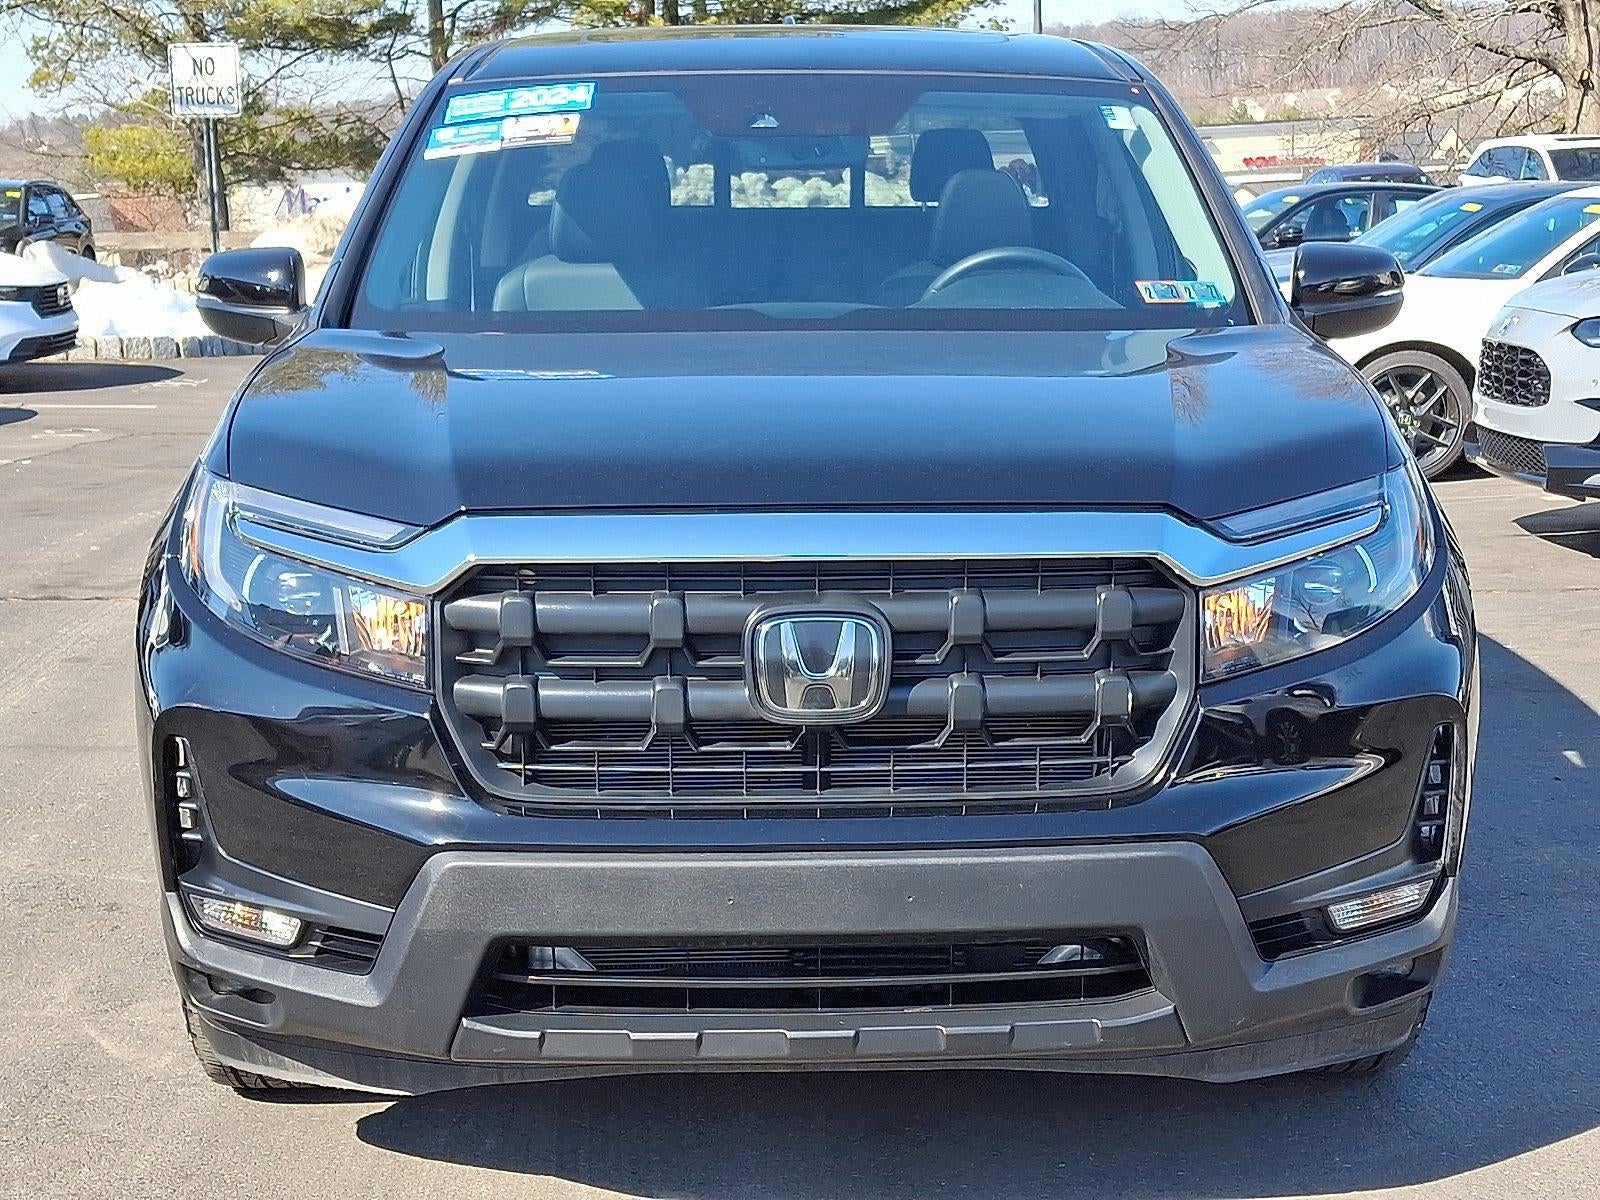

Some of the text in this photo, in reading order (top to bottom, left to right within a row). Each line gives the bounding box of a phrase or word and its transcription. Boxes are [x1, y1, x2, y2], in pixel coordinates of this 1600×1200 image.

[192, 57, 215, 76] NO
[176, 86, 235, 106] TRUCKS
[510, 86, 587, 109] 2024
